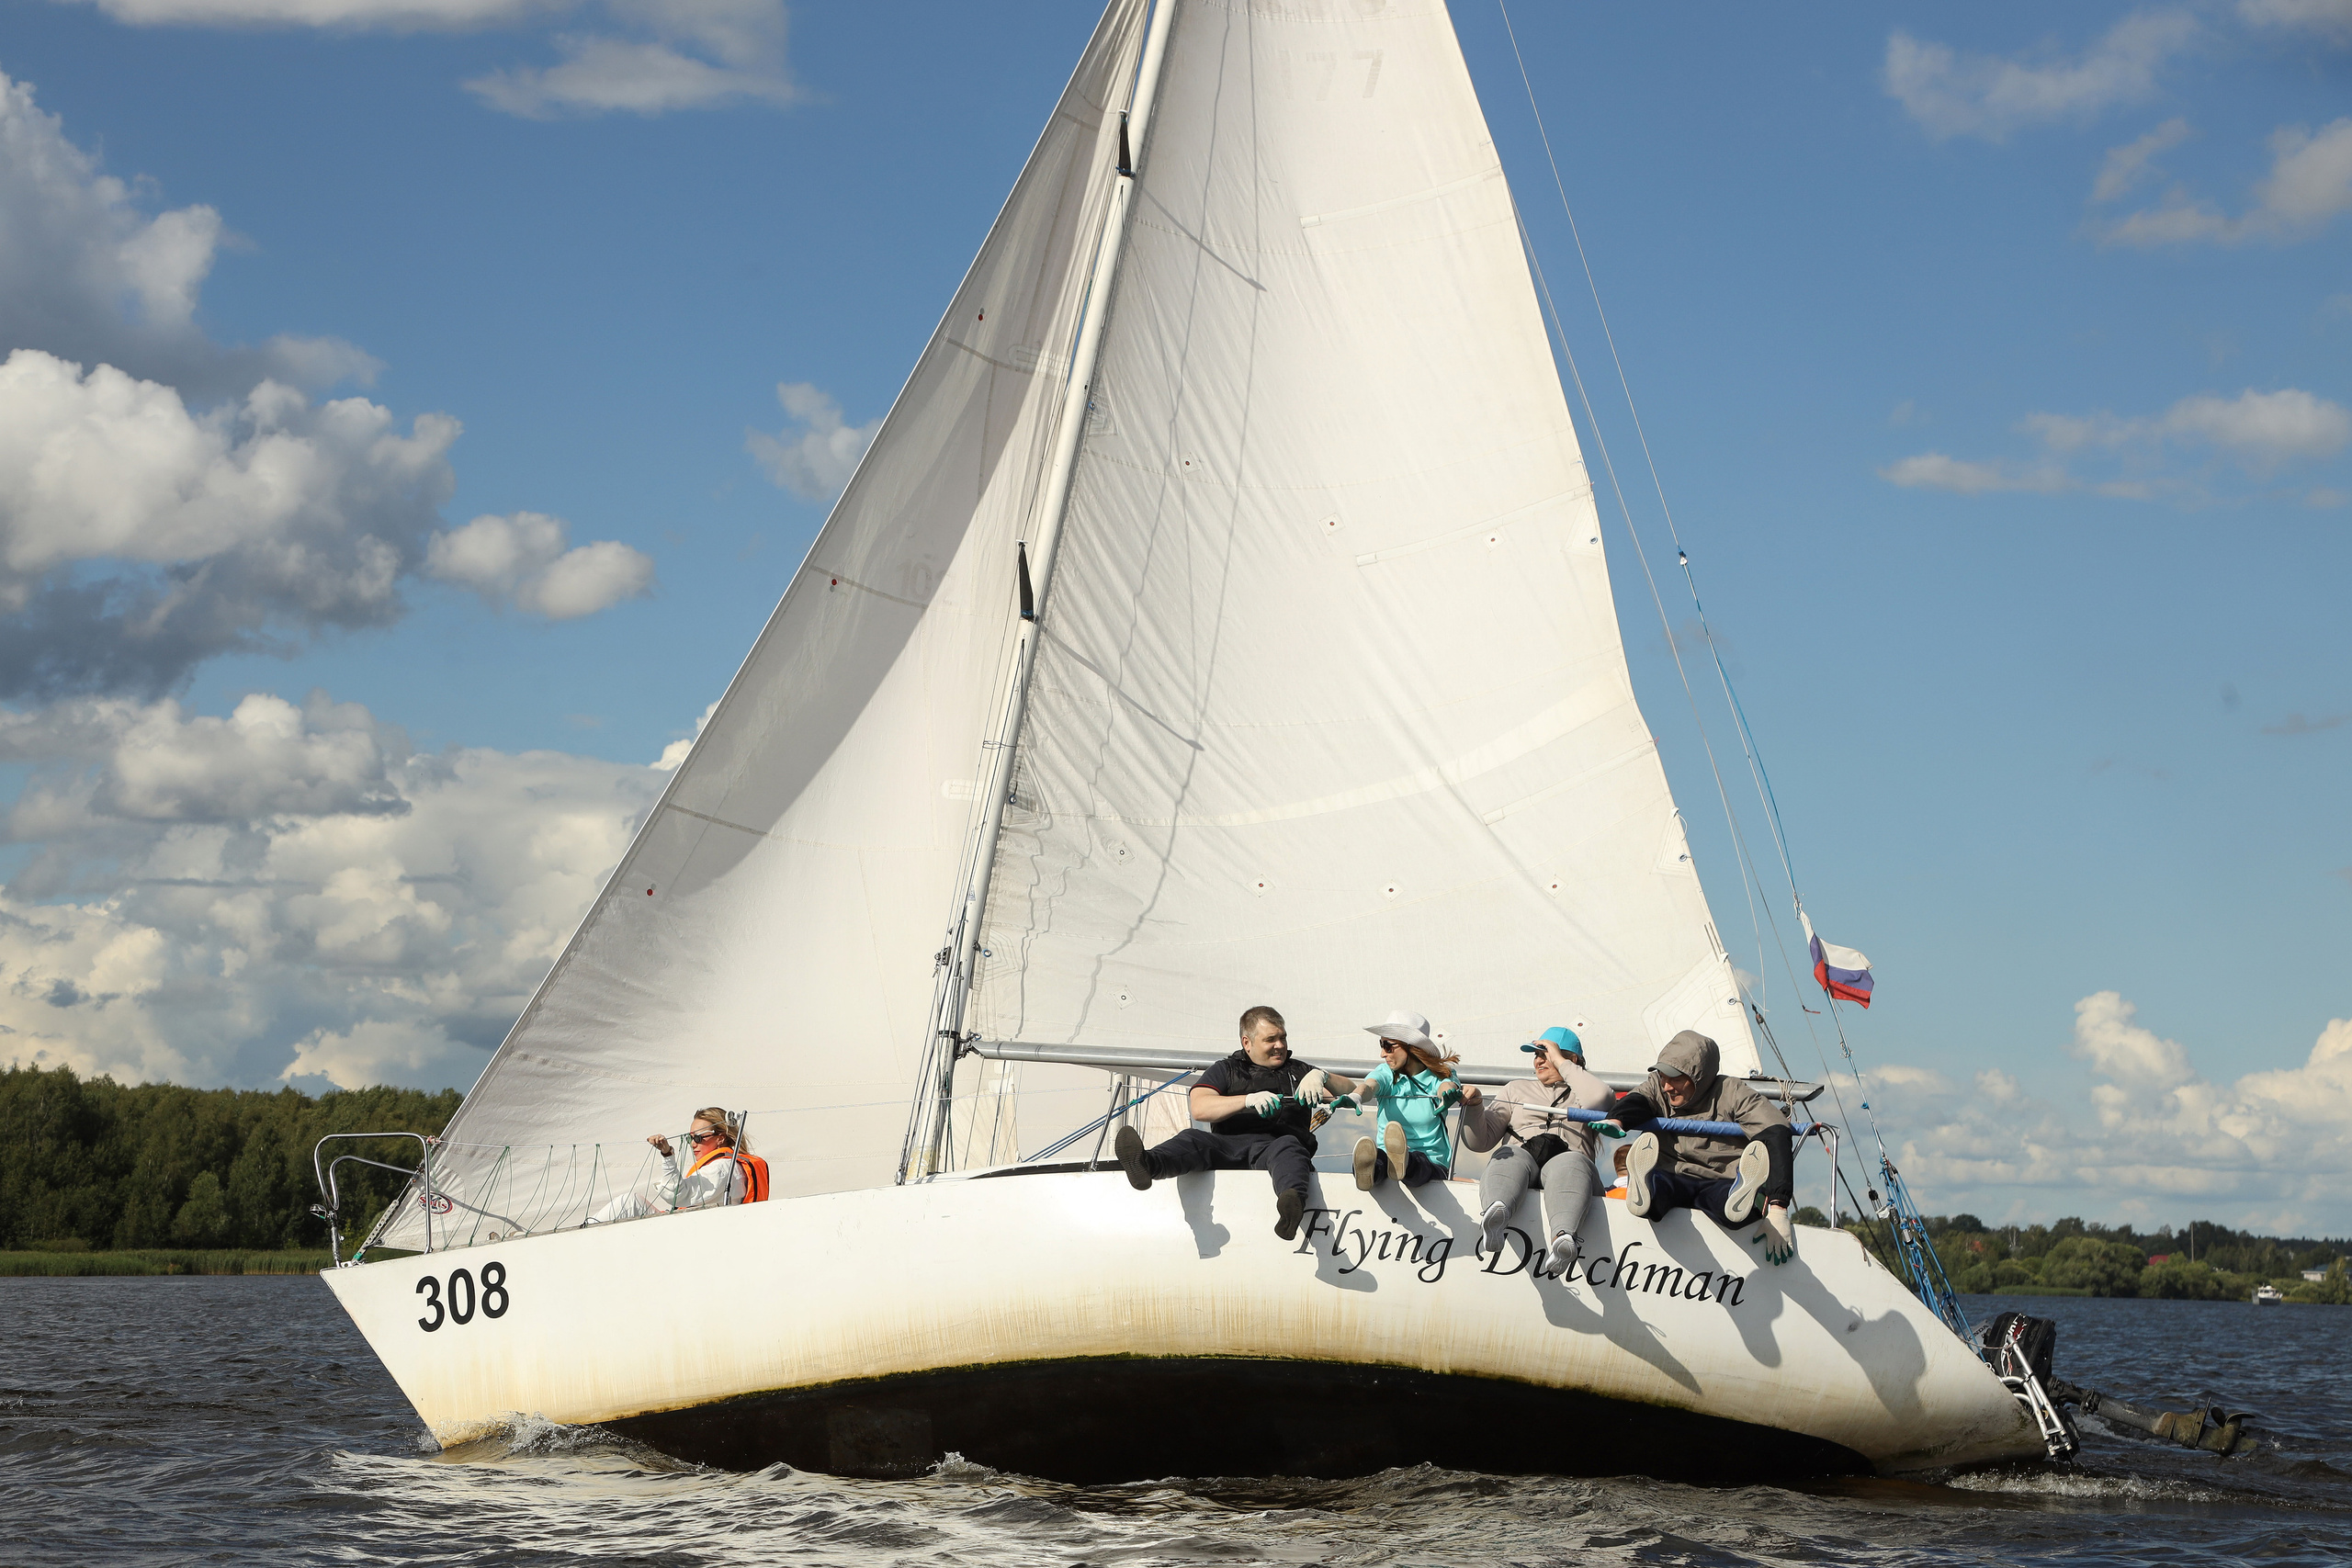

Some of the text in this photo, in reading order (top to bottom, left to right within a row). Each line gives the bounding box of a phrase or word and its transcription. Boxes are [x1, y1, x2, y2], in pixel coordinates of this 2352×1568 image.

[1294, 1209, 1745, 1307] Flying Dutchman
[415, 1261, 510, 1333] 308
[1965, 1325, 1990, 1343] ONDA
